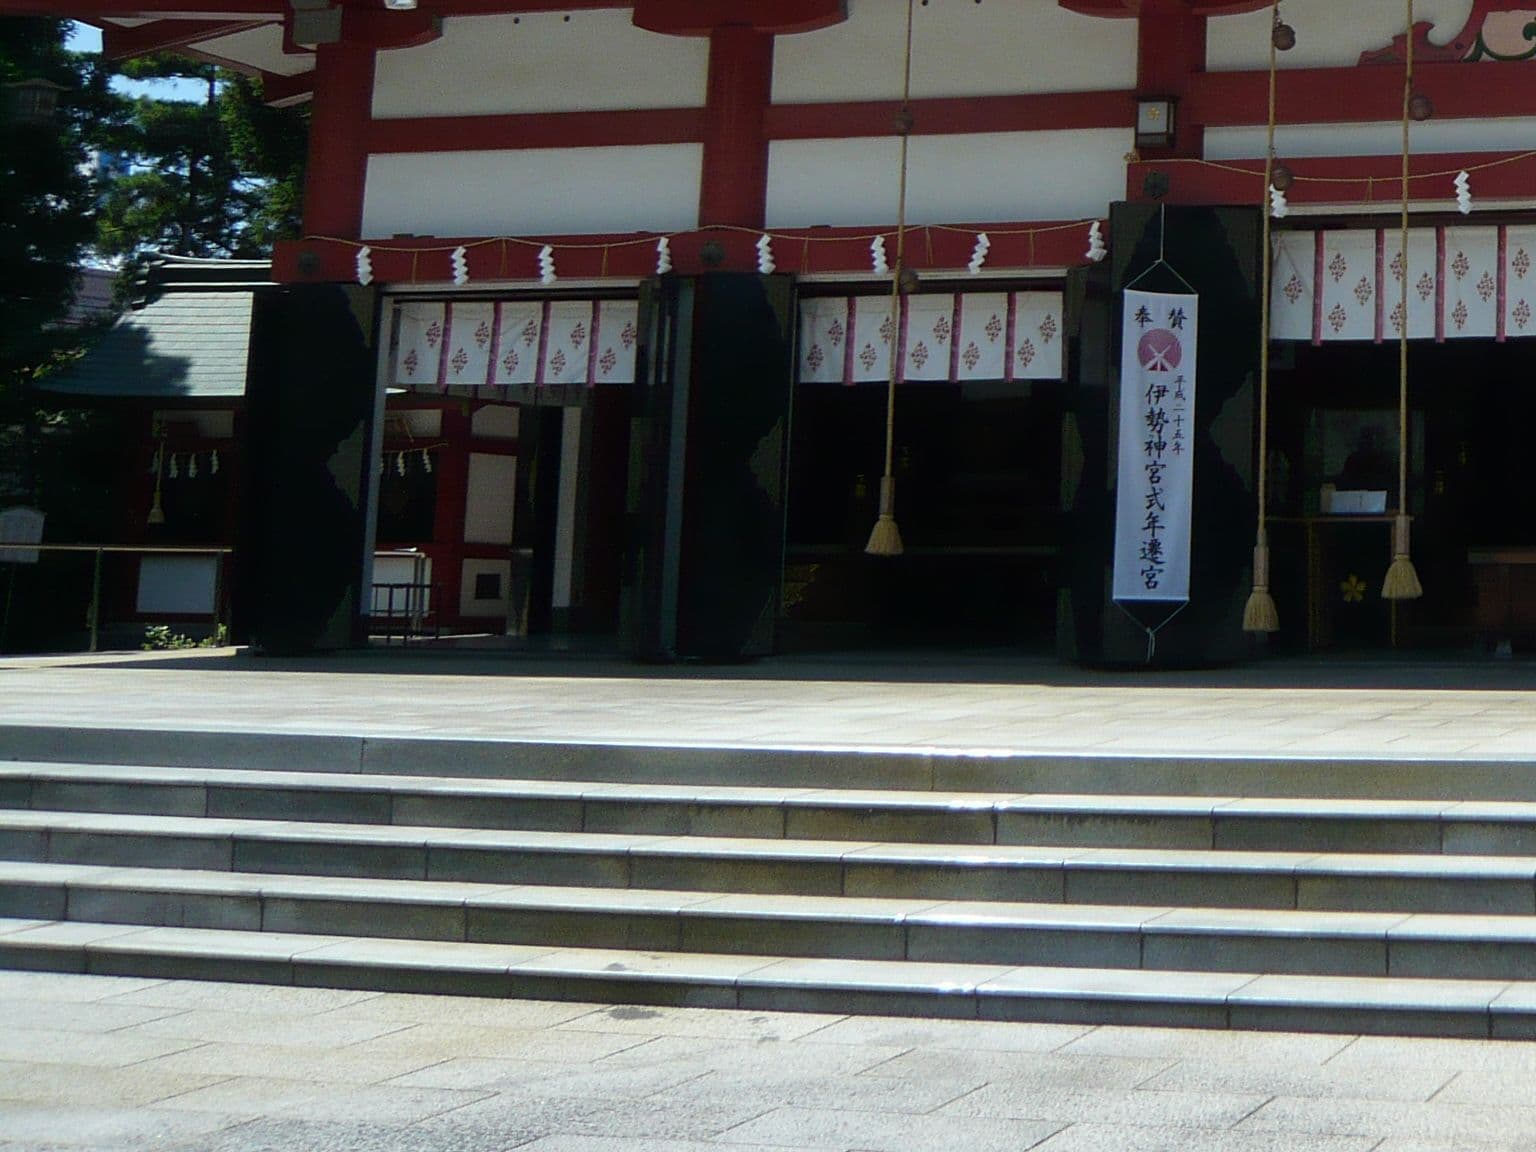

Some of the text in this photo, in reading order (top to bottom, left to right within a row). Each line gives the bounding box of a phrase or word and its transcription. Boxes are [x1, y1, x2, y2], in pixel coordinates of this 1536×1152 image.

[1134, 304, 1189, 331] 奉賛
[1171, 374, 1187, 456] 平成二十五年
[1138, 382, 1171, 591] 伊勢神宮式年遷宮
